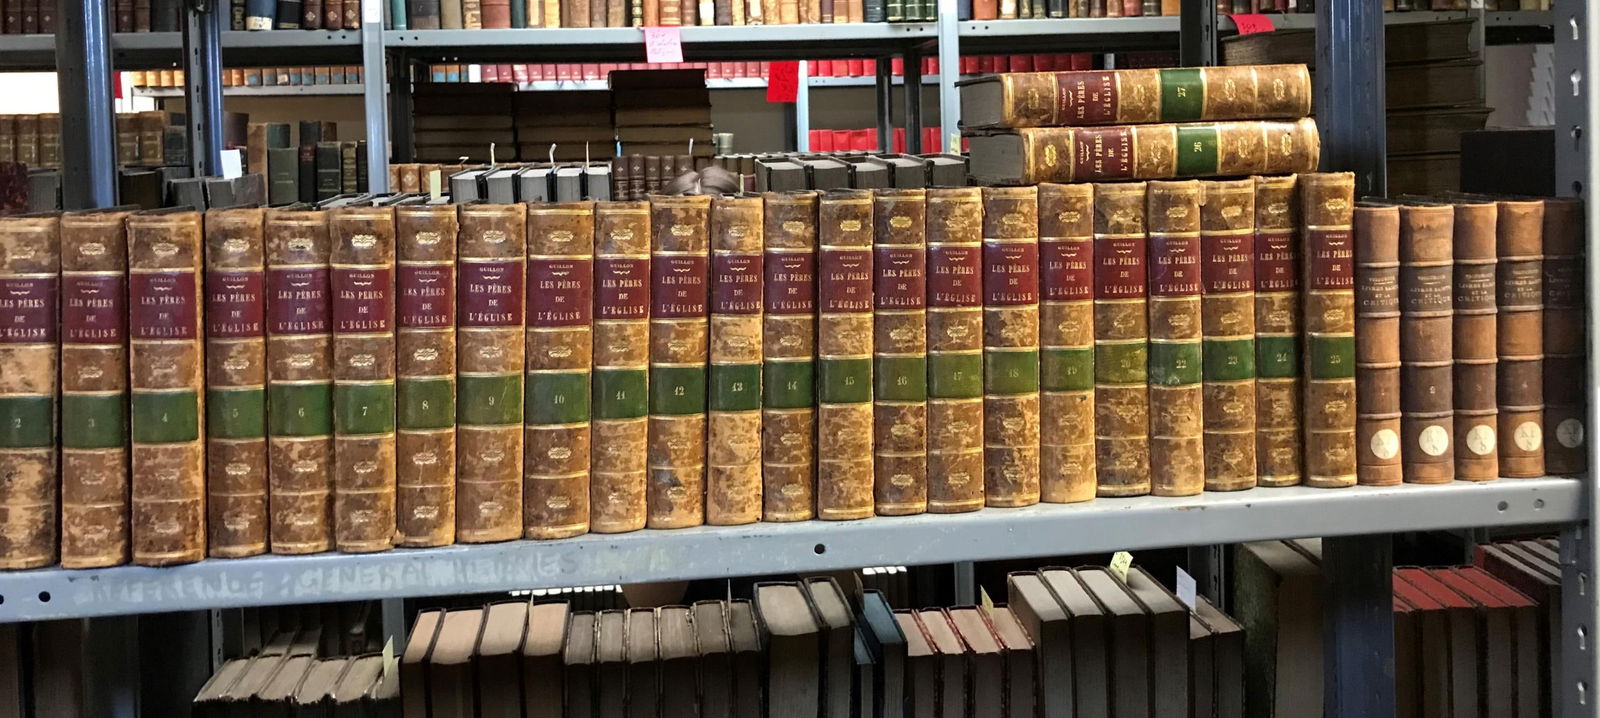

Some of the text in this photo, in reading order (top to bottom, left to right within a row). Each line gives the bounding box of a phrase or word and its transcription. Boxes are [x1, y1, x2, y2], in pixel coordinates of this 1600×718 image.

[1092, 92, 1098, 101] DE
[1177, 87, 1186, 97] 27
[1194, 141, 1202, 152] 26
[1108, 147, 1114, 157] DE
[1158, 256, 1172, 264] LES
[883, 269, 896, 277] LES
[936, 265, 949, 274] LES
[992, 265, 1005, 273] LES
[662, 276, 675, 284] LES
[719, 275, 733, 283] LES
[774, 274, 787, 282] LES
[470, 284, 484, 292] LES
[540, 280, 554, 289] LES
[603, 279, 617, 288] LES
[278, 290, 293, 299] LES
[341, 290, 355, 299] LES
[69, 299, 83, 307] LES
[141, 297, 156, 305] LES
[14, 315, 25, 323] DE
[1228, 356, 1238, 366] 23
[1276, 353, 1287, 362] 24
[1330, 355, 1341, 364] 25
[1176, 359, 1186, 369] 22
[952, 372, 962, 381] 17
[1008, 369, 1019, 378] 18
[845, 377, 854, 385] 15
[897, 376, 907, 385] 16
[732, 382, 743, 392] 13
[787, 382, 797, 390] 14
[615, 390, 625, 400] 11
[674, 386, 685, 396] 12
[488, 396, 495, 406] 9
[554, 394, 565, 404] 10
[422, 400, 429, 410] 8
[233, 408, 239, 418] 5
[298, 407, 305, 417] 6
[362, 407, 368, 416] 7
[162, 412, 168, 423] 4
[15, 417, 21, 428] 2
[88, 417, 95, 428] 3
